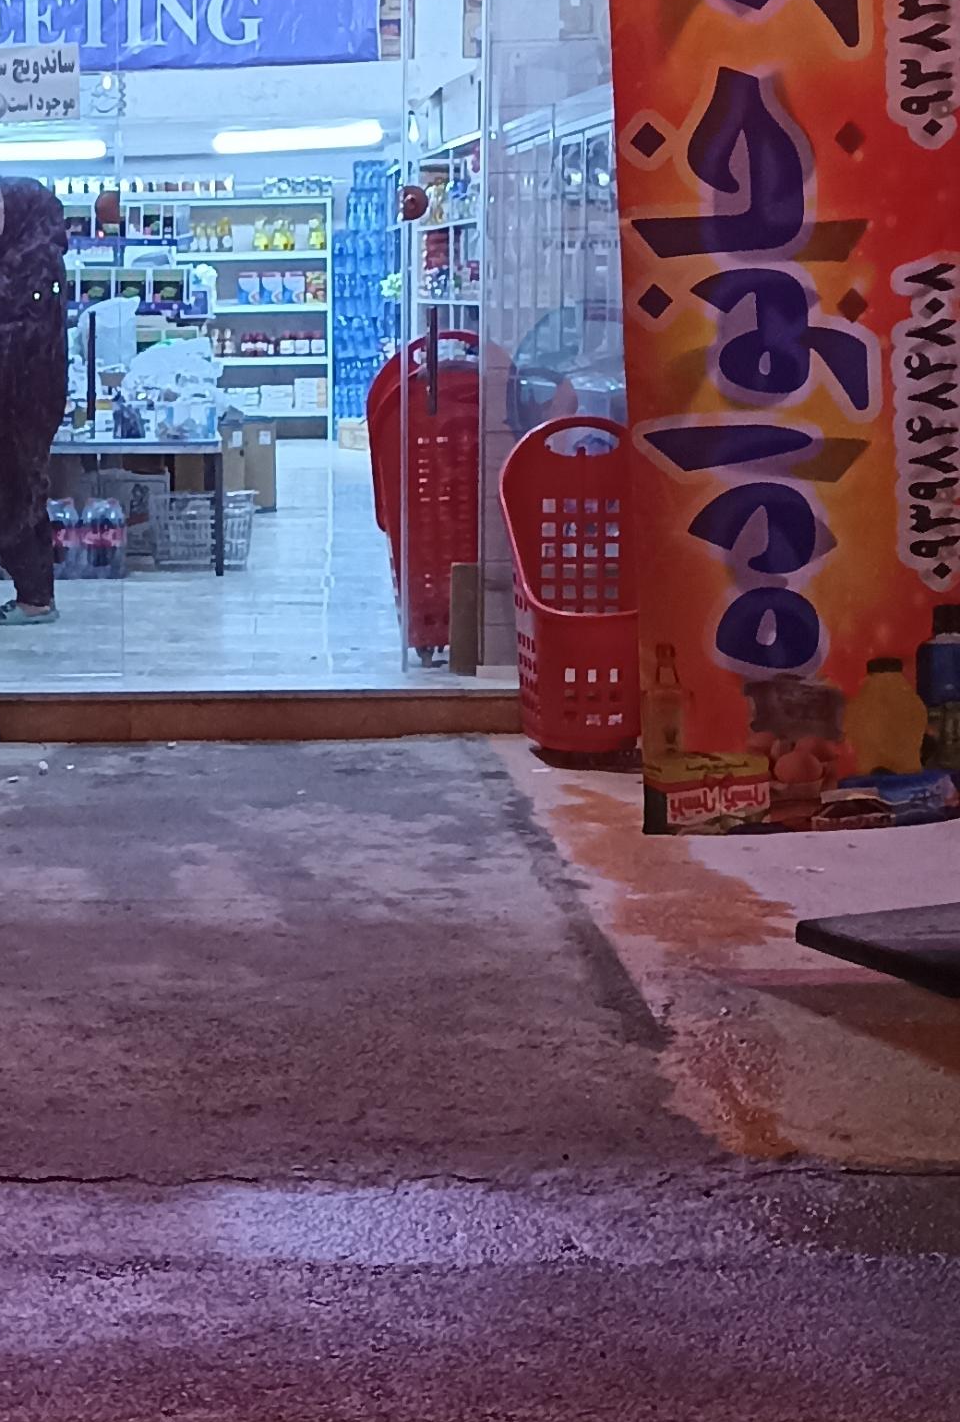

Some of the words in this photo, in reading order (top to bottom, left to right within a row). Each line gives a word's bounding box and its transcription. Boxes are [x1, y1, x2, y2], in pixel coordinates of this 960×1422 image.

[8, 92, 33, 114] است
[36, 93, 76, 117] موجود
[628, 63, 874, 673] خانواده
